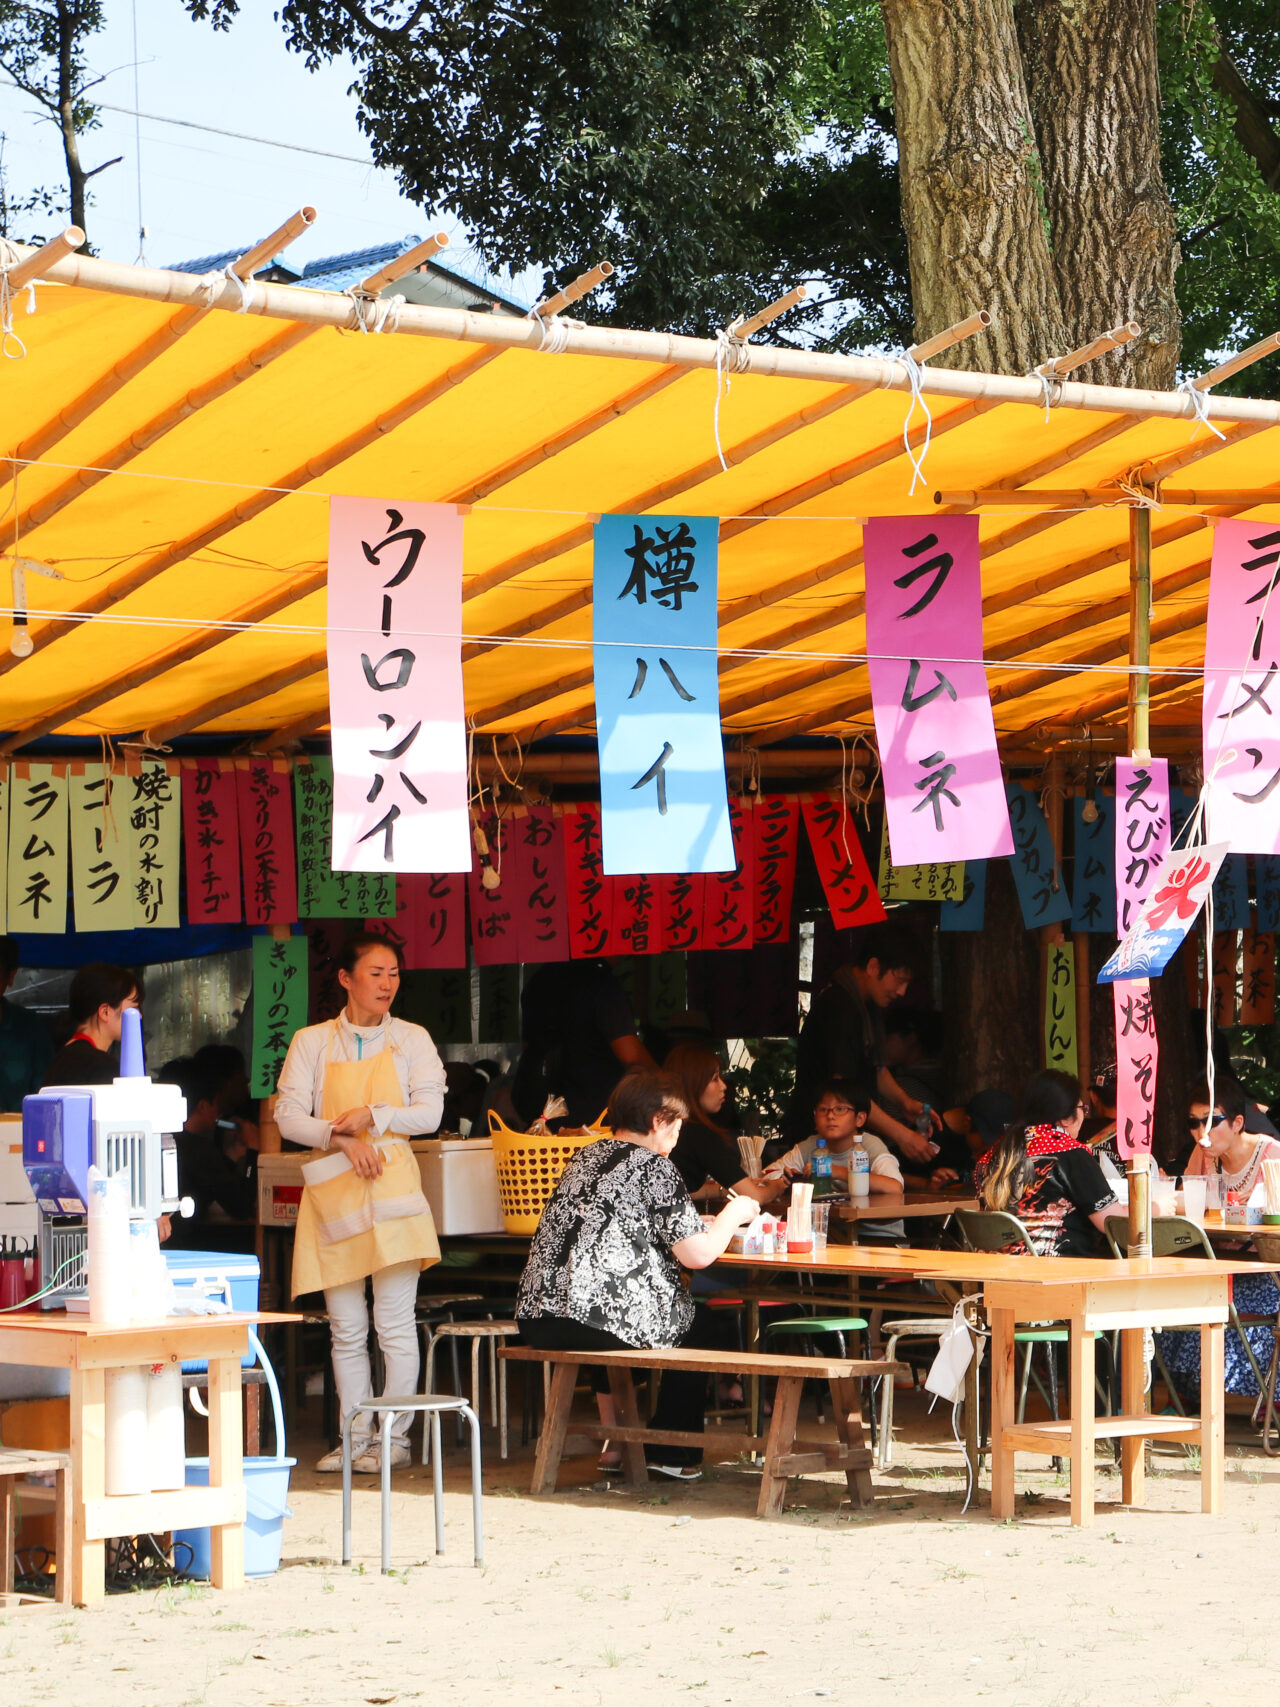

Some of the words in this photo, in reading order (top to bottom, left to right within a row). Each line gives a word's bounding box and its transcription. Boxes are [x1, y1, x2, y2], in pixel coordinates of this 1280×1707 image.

[357, 509, 428, 862] ウーロンハイ
[617, 522, 699, 816] 樽ハイ
[893, 533, 961, 832] ラムネ
[18, 781, 58, 919] ラムネ
[83, 778, 120, 905] コーラ
[130, 764, 172, 924] 焼酎の水割り
[194, 769, 230, 914] かき氷イチゴ
[251, 768, 279, 922] きゅうりの一本漬け
[429, 873, 451, 946] とり
[523, 815, 556, 941] おしんこ
[756, 801, 790, 941] ニンニクラーメン
[813, 801, 869, 913] ラーメン
[621, 877, 653, 951] 味噌
[664, 875, 698, 949] ラーメン
